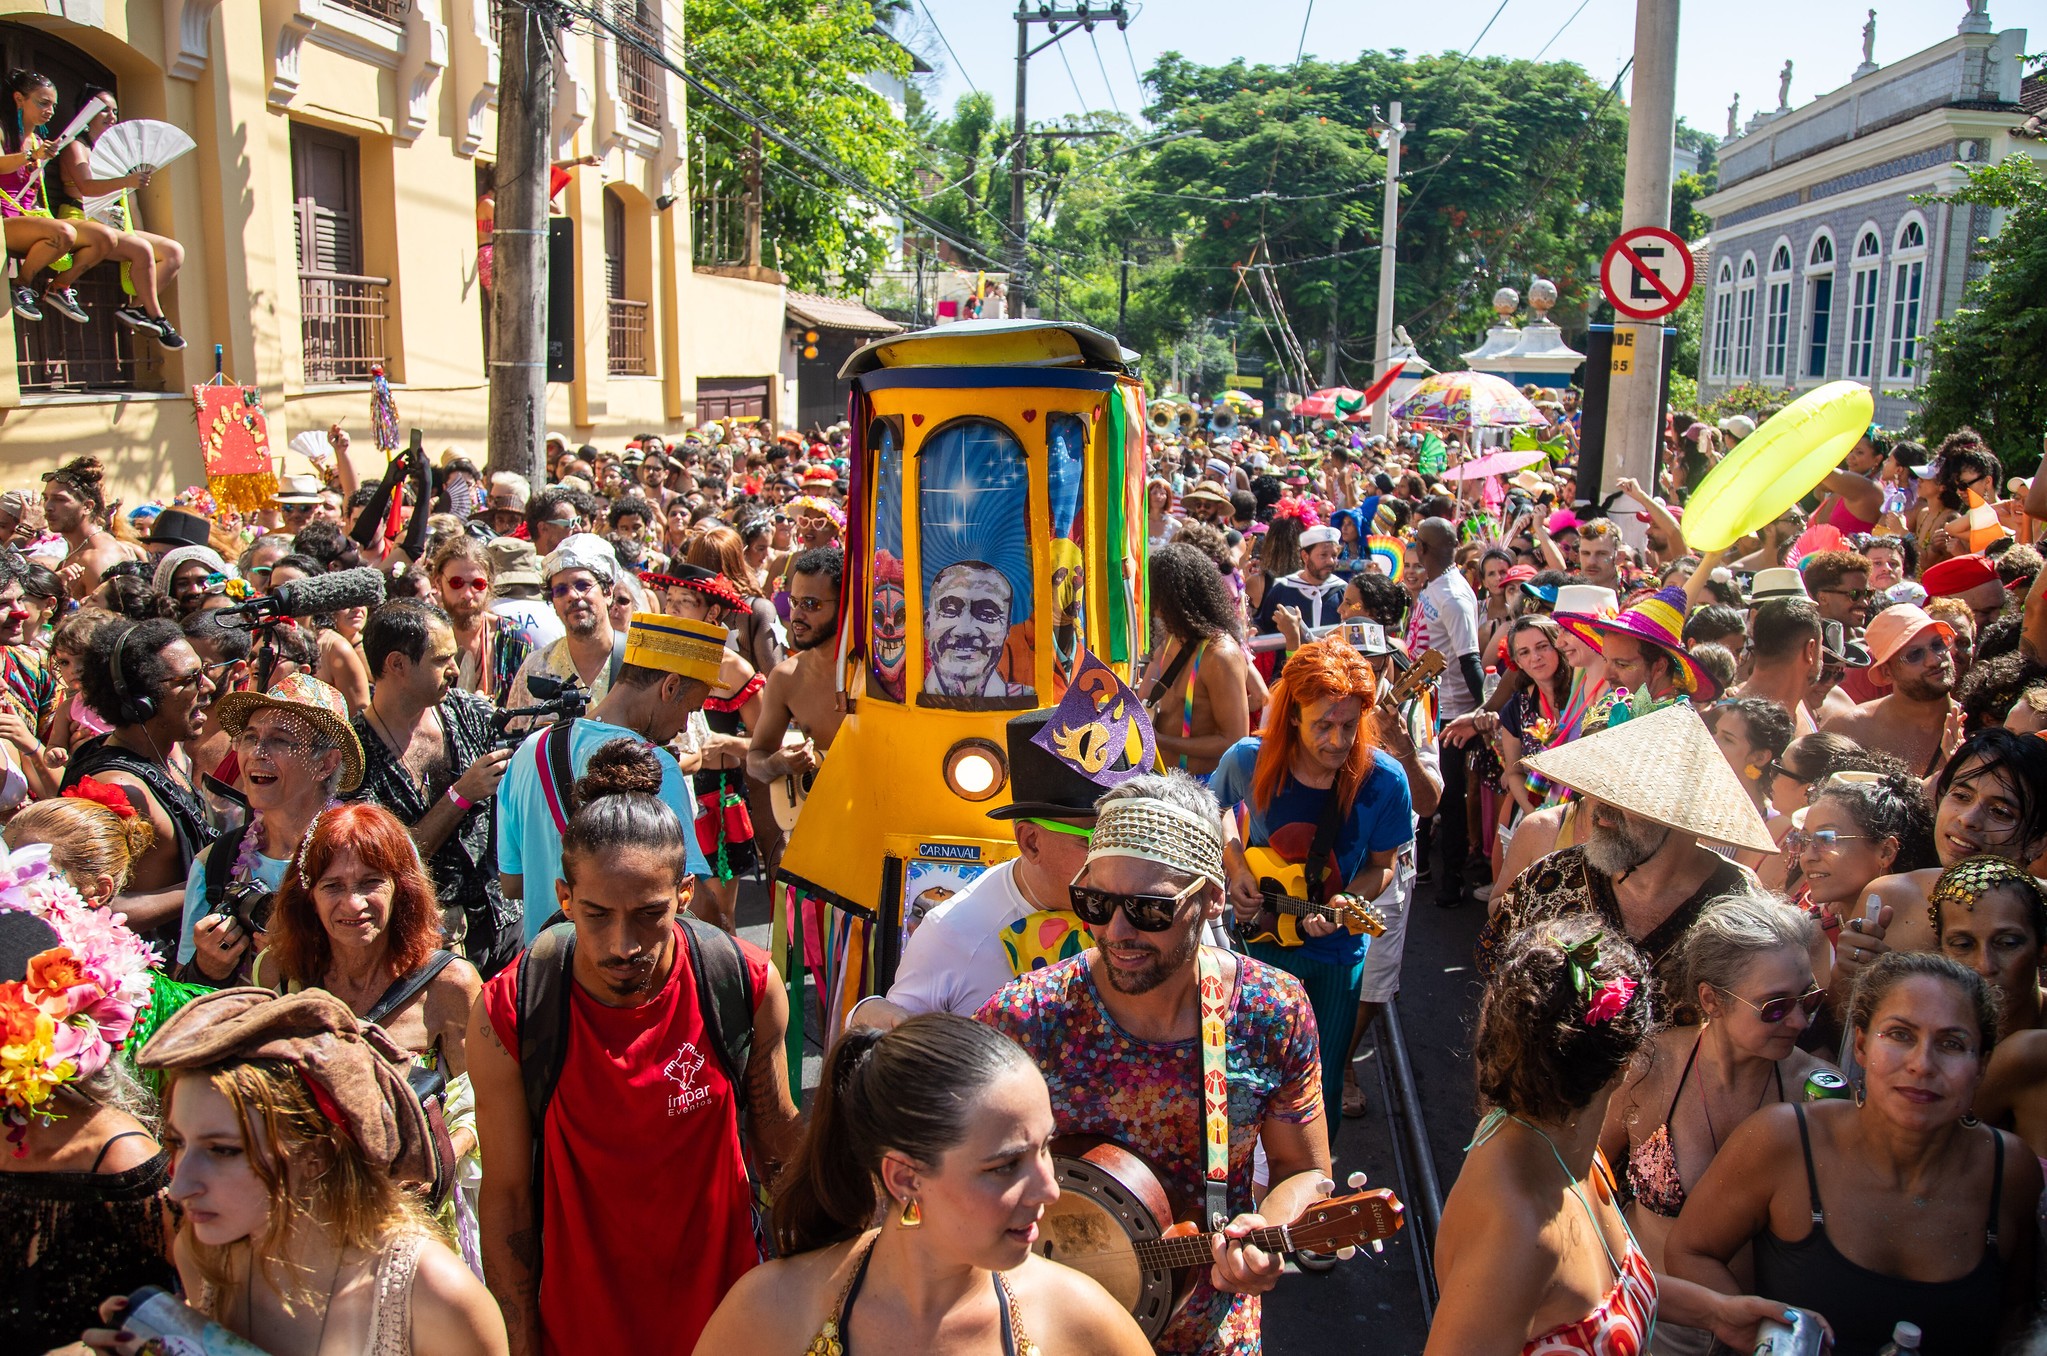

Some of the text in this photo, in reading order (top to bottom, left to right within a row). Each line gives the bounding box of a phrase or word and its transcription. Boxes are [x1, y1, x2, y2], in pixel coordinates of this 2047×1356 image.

[1630, 247, 1665, 299] E
[1612, 360, 1629, 371] 65
[919, 844, 979, 859] CARNAVAL
[668, 1084, 711, 1108] ímpar
[668, 1098, 713, 1117] Eventos
